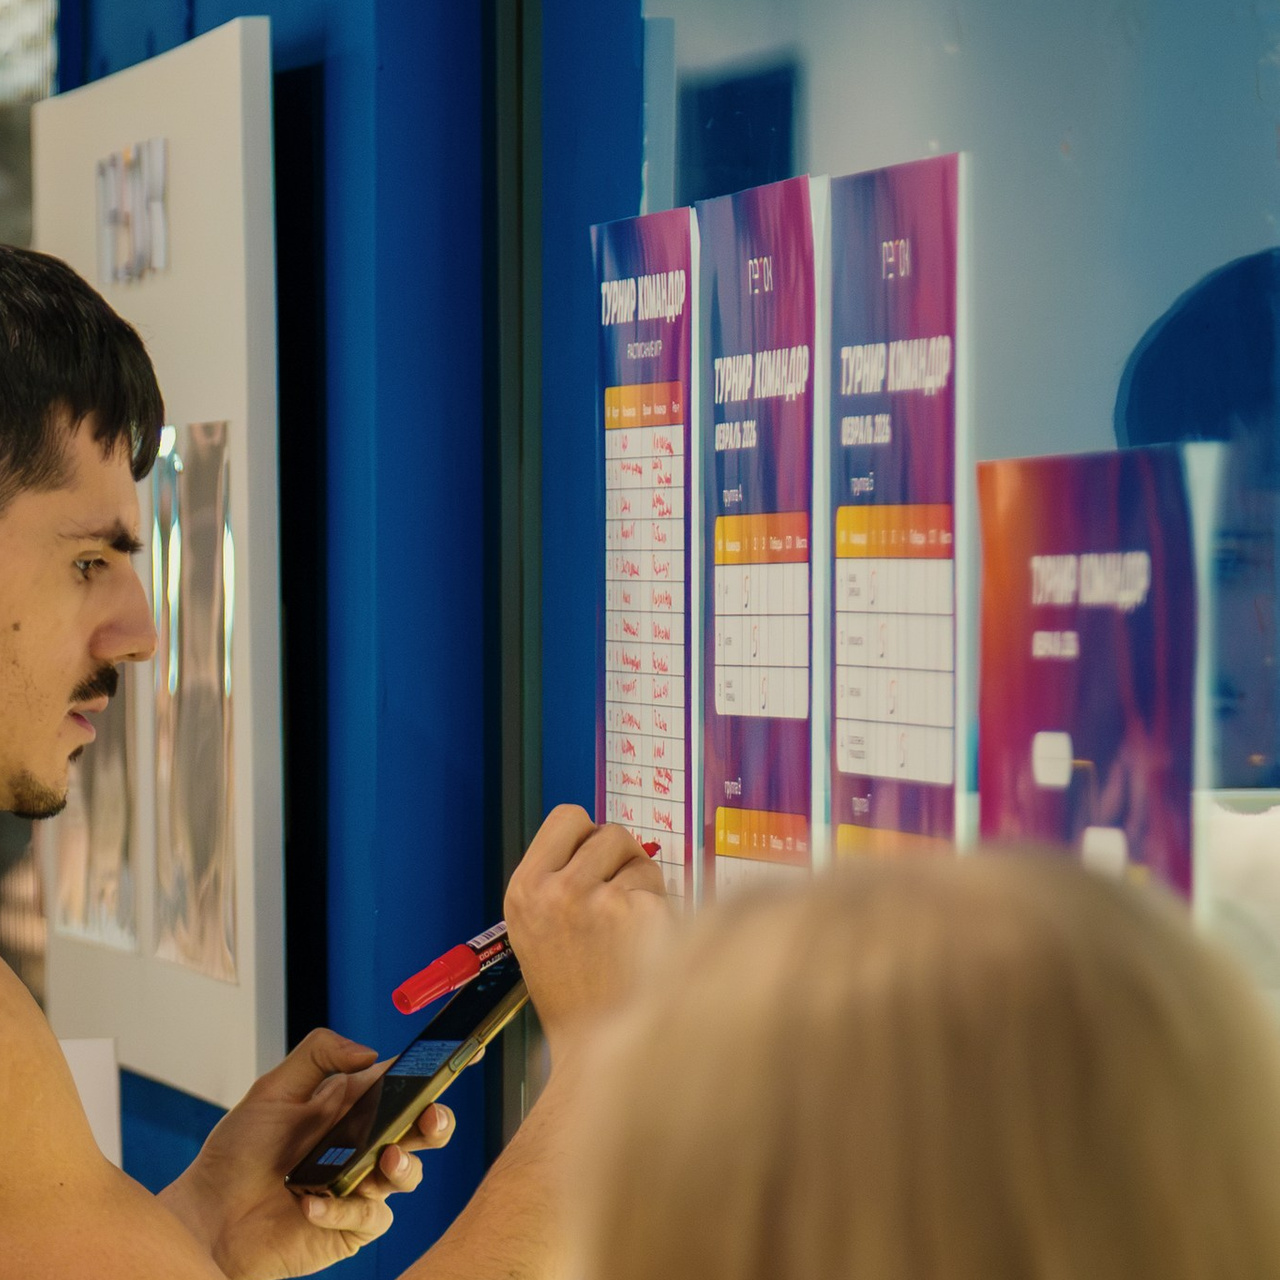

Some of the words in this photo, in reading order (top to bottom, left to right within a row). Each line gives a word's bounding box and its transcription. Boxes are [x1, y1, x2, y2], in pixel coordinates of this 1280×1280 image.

[601, 277, 637, 326] ТУРНИР
[637, 269, 686, 323] КОМАНДОР
[714, 353, 753, 404] ТУРНИР
[753, 345, 810, 402] КОМАНДОР
[841, 342, 887, 396] ТУРНИР
[887, 335, 951, 396] КОМАНДОР
[715, 421, 742, 451] ФЕВРАЛЬ
